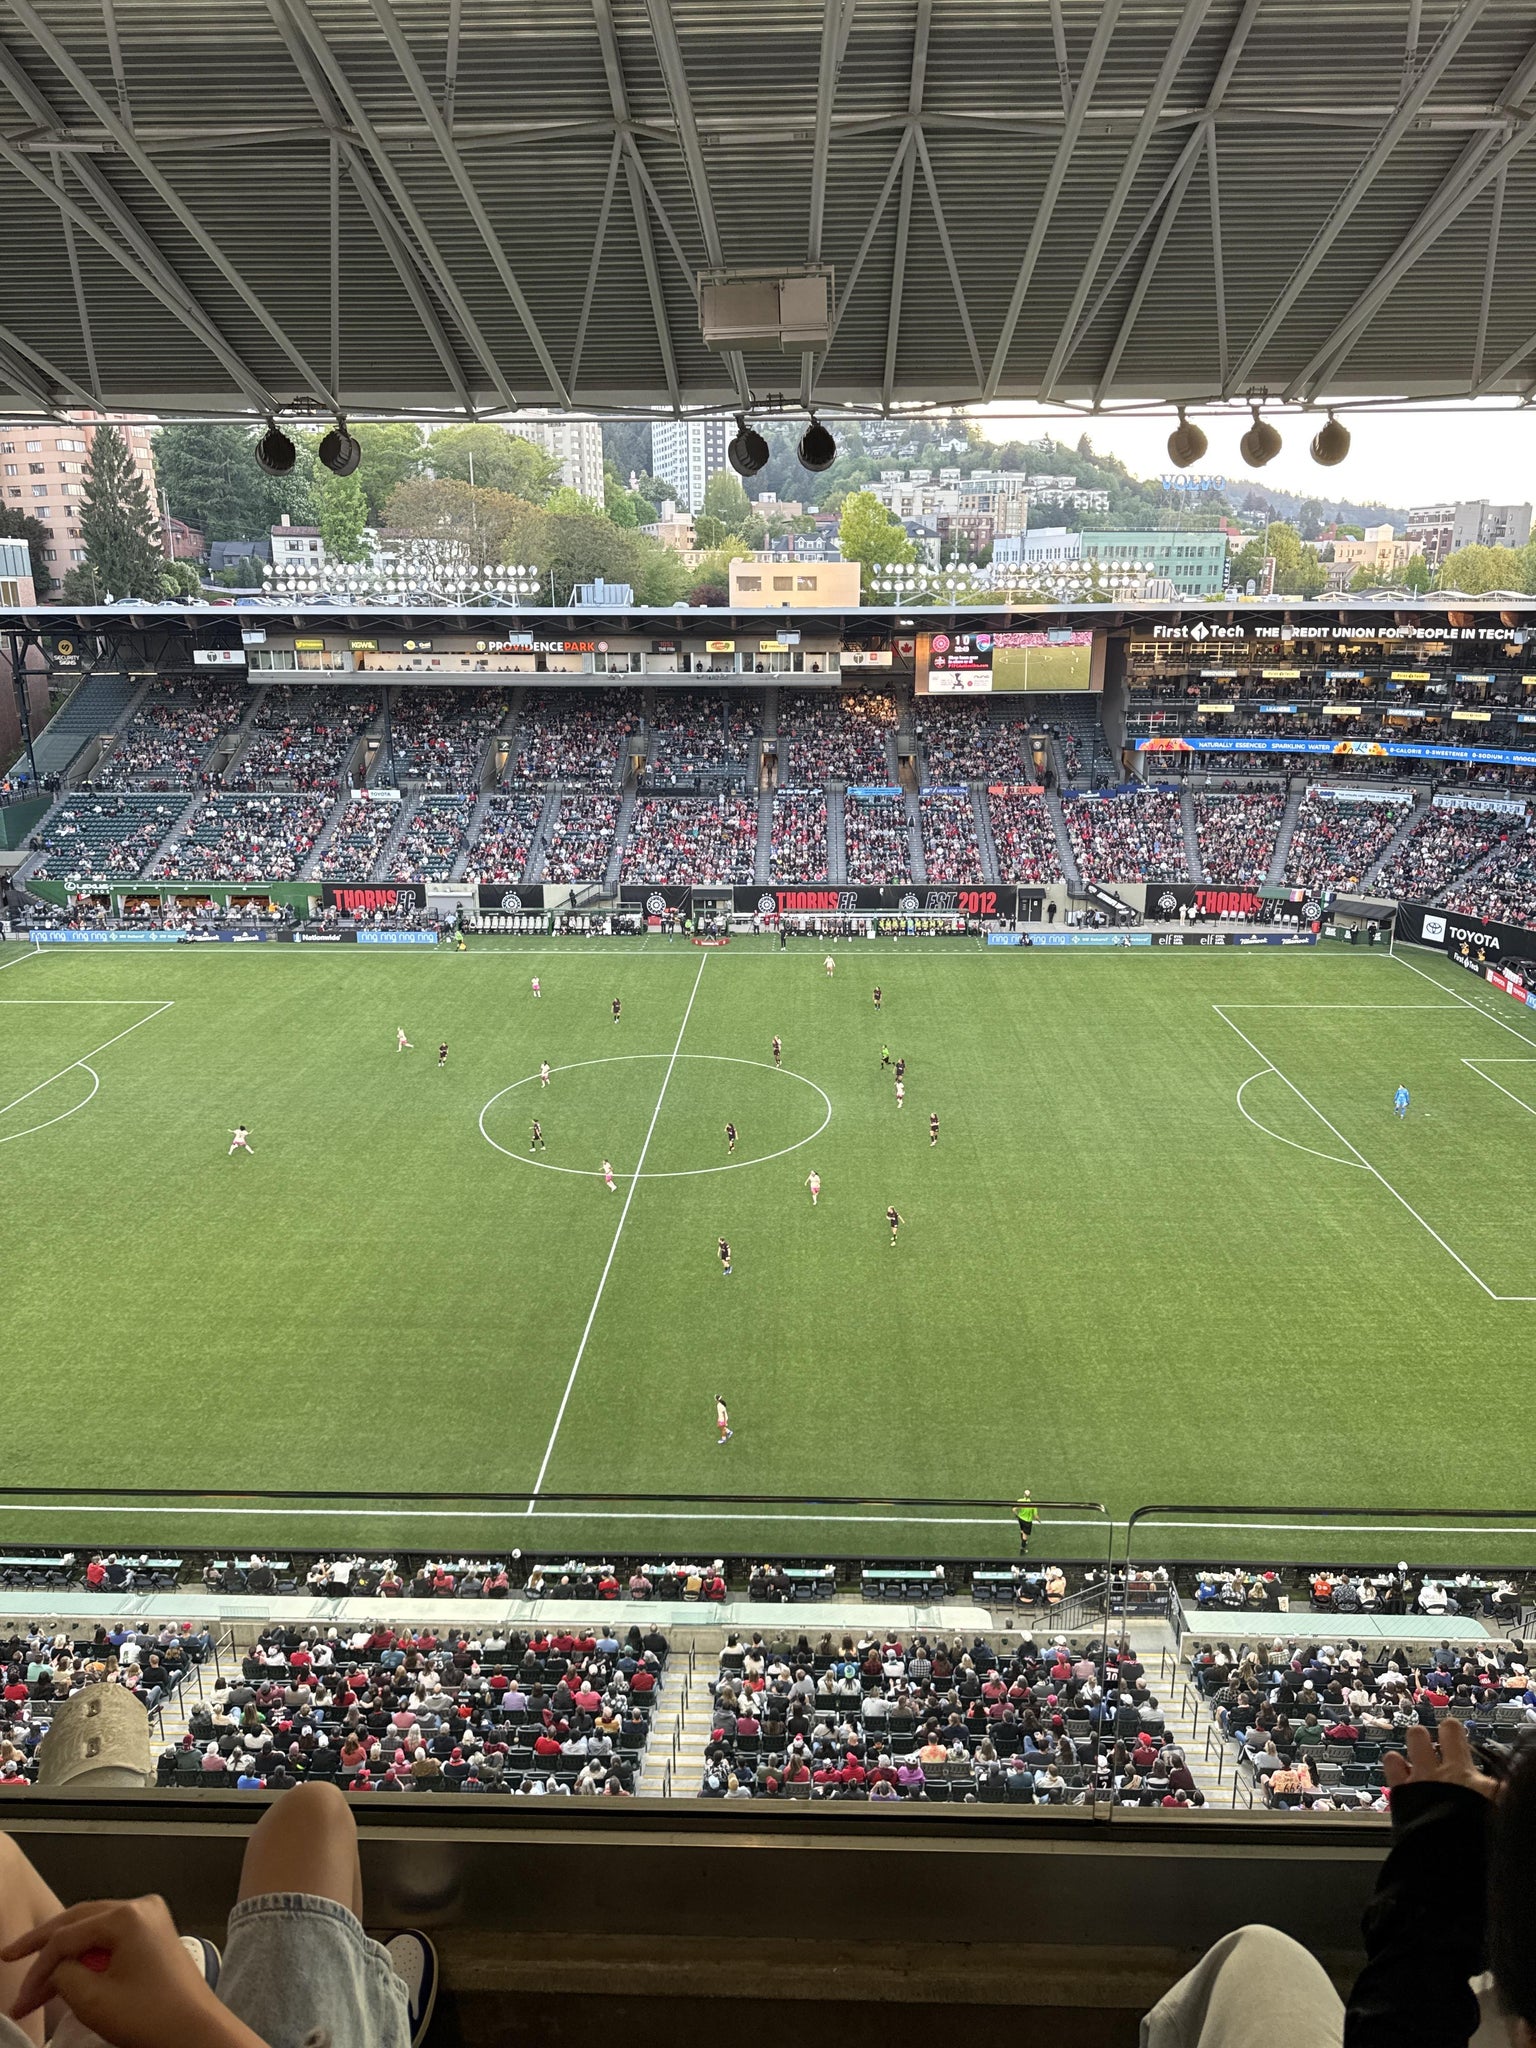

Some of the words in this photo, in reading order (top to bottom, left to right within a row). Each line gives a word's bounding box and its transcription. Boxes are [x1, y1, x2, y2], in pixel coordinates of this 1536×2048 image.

[1160, 474, 1226, 491] VOLVO
[1153, 625, 1189, 638] First
[1210, 625, 1245, 638] Tech
[1255, 627, 1280, 638] THE
[1290, 627, 1329, 638] REDIT
[1332, 627, 1375, 638] UNION
[1408, 628, 1458, 639] PEOPLE
[1461, 629, 1476, 640] IN
[1478, 629, 1515, 640] TECH
[925, 891, 958, 913] EST
[958, 891, 997, 913] 2012
[50, 932, 66, 941] ring
[73, 932, 89, 941] ring
[91, 932, 107, 941] ring
[362, 933, 378, 942] ring
[380, 933, 396, 942] ring
[399, 933, 415, 942] ring
[417, 933, 433, 942] ring
[992, 934, 1008, 944] ring
[1049, 934, 1065, 944] ring
[1449, 927, 1500, 950] TOYOTA
[1454, 952, 1464, 964] First
[1468, 959, 1479, 972] Tech
